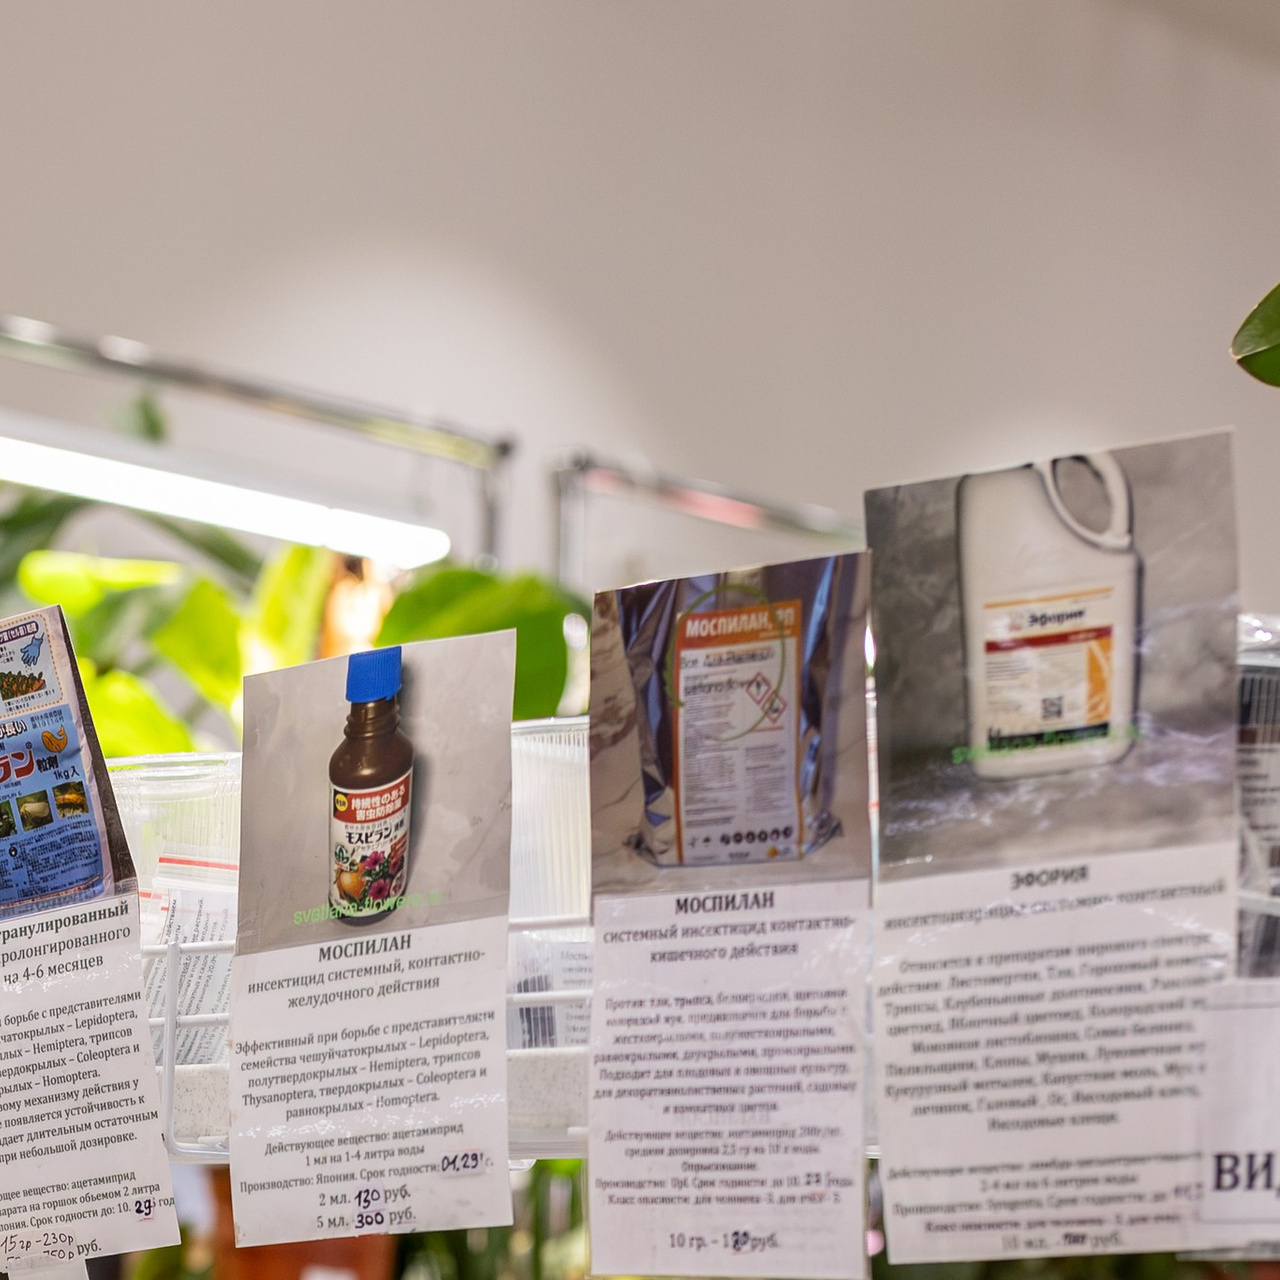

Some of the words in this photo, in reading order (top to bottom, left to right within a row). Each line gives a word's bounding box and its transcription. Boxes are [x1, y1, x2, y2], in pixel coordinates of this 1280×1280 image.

[37, 755, 60, 773] 粒剤
[53, 766, 80, 781] 1kg入
[675, 891, 774, 914] МОСПИЛАН
[318, 934, 410, 962] МОСПИЛАН
[2, 972, 19, 985] на
[22, 963, 45, 981] 4-6
[47, 954, 104, 977] месяцев
[248, 973, 324, 993] инсектицид
[328, 958, 404, 981] системный,
[408, 950, 484, 970] контактно-
[288, 987, 374, 1008] желудочного
[377, 977, 439, 997] действия
[1212, 1152, 1280, 1199] ВИ
[328, 1216, 349, 1229] мл.
[355, 1212, 384, 1229] 300
[389, 1208, 416, 1225] руб.
